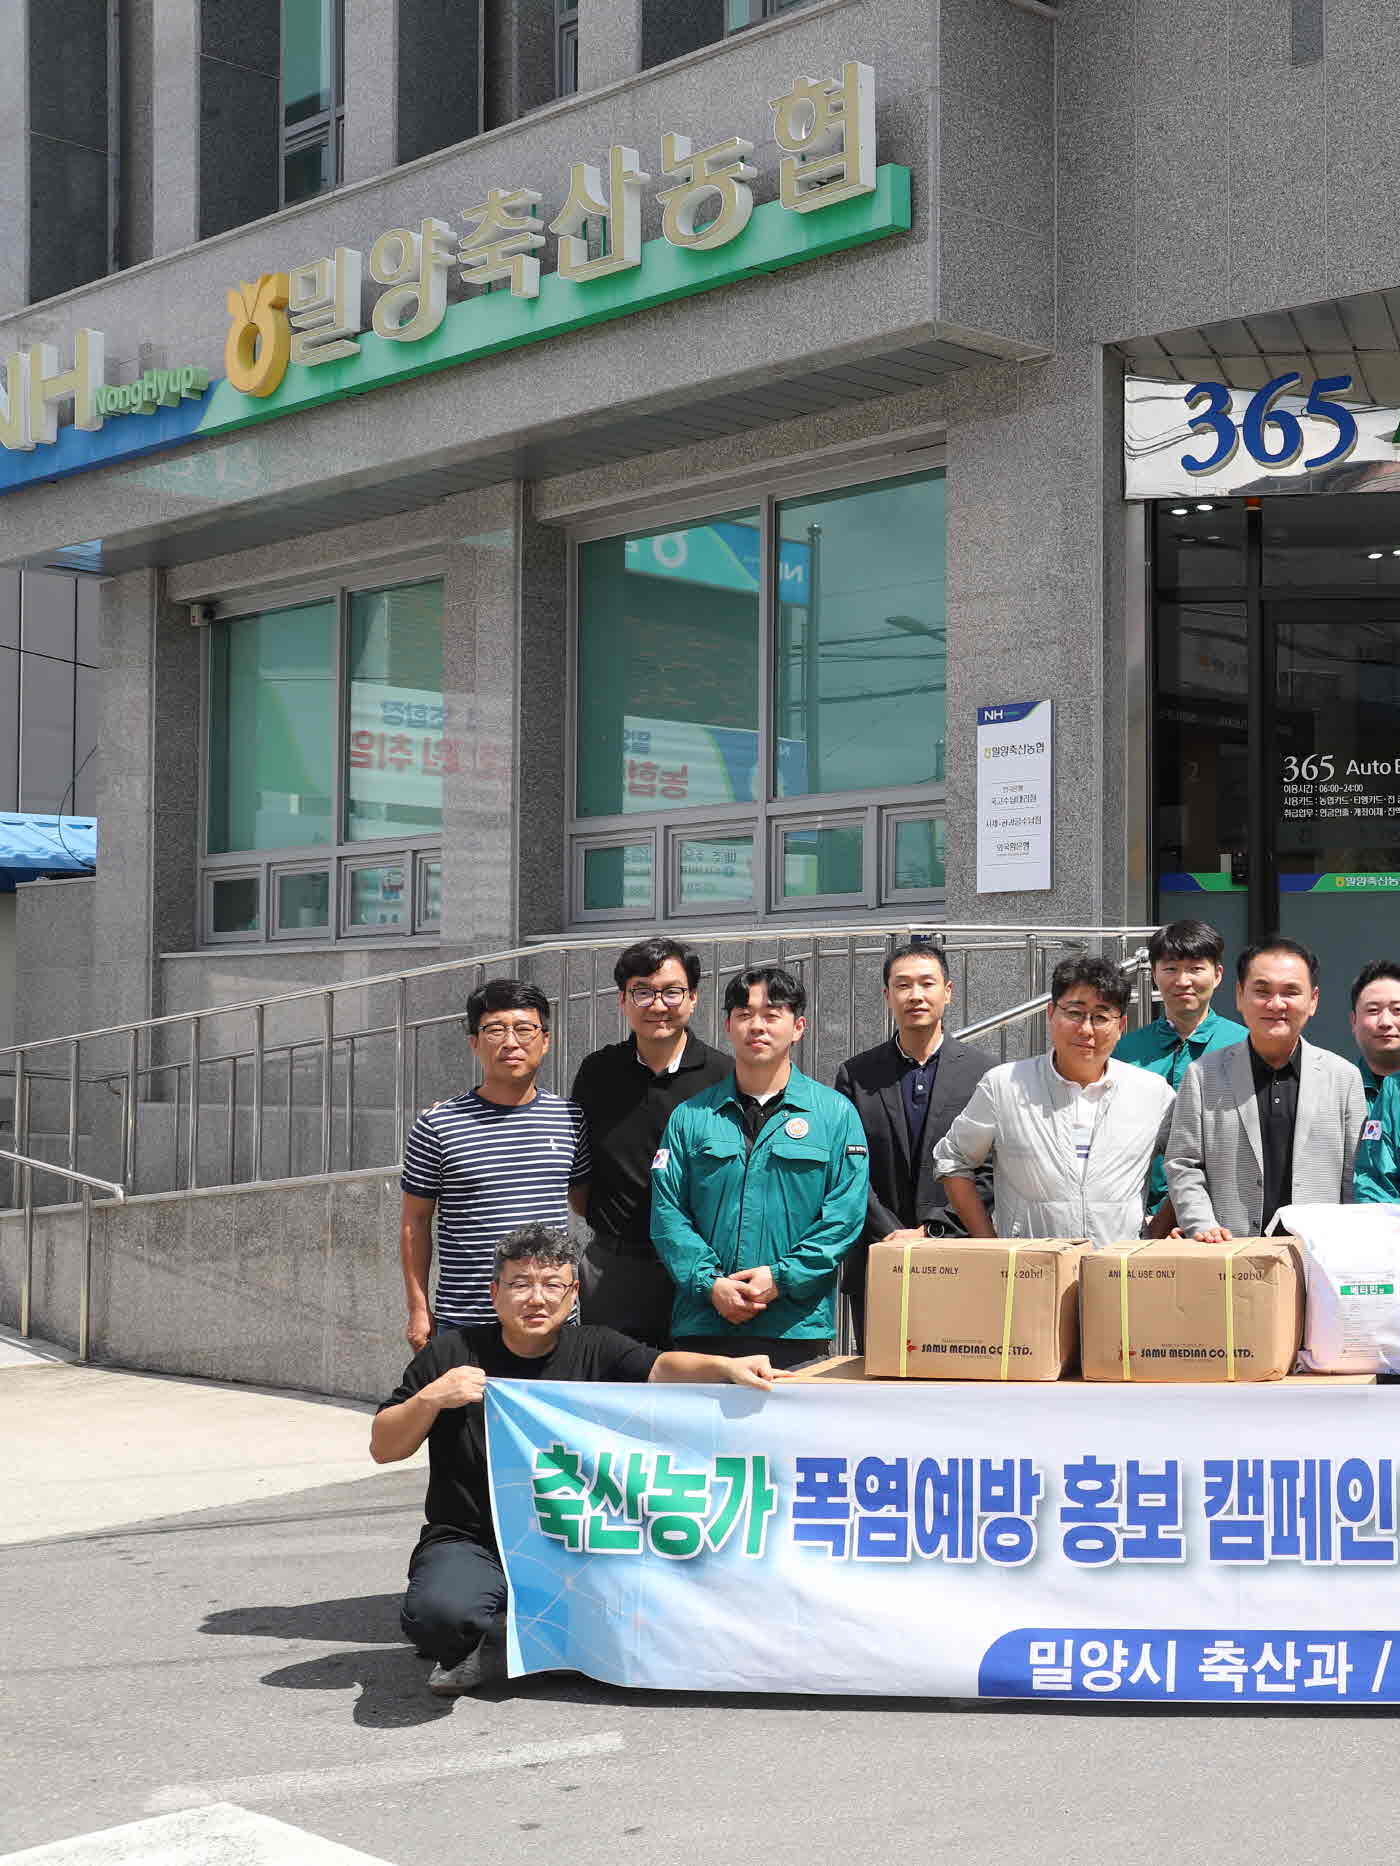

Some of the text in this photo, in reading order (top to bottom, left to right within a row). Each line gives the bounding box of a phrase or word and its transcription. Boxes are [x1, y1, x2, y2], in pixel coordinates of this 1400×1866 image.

[289, 61, 876, 368] 밀양축산농협
[1181, 372, 1358, 477] 365
[984, 709, 1003, 721] NH
[1283, 753, 1335, 782] 365
[1346, 759, 1391, 776] Auto
[1283, 784, 1313, 794] 이용시간
[1283, 796, 1313, 806] 사용카드
[922, 1266, 936, 1274] USE
[939, 1266, 959, 1275] ONLY
[1138, 1270, 1153, 1279] USE
[1156, 1270, 1176, 1279] ONLY
[921, 1344, 947, 1353] SAMU
[949, 1344, 987, 1354] MEDIAN
[1141, 1349, 1167, 1358] SAMU
[1169, 1349, 1207, 1358] MEDIAN
[533, 1442, 775, 1561] 축산농가
[793, 1453, 1044, 1565] 폭염예방
[1061, 1453, 1186, 1566] 홍보
[1201, 1455, 1398, 1567] 캠페인
[1028, 1639, 1178, 1695] 밀양시
[1200, 1639, 1352, 1697] 축산과
[1371, 1641, 1393, 1692] /
